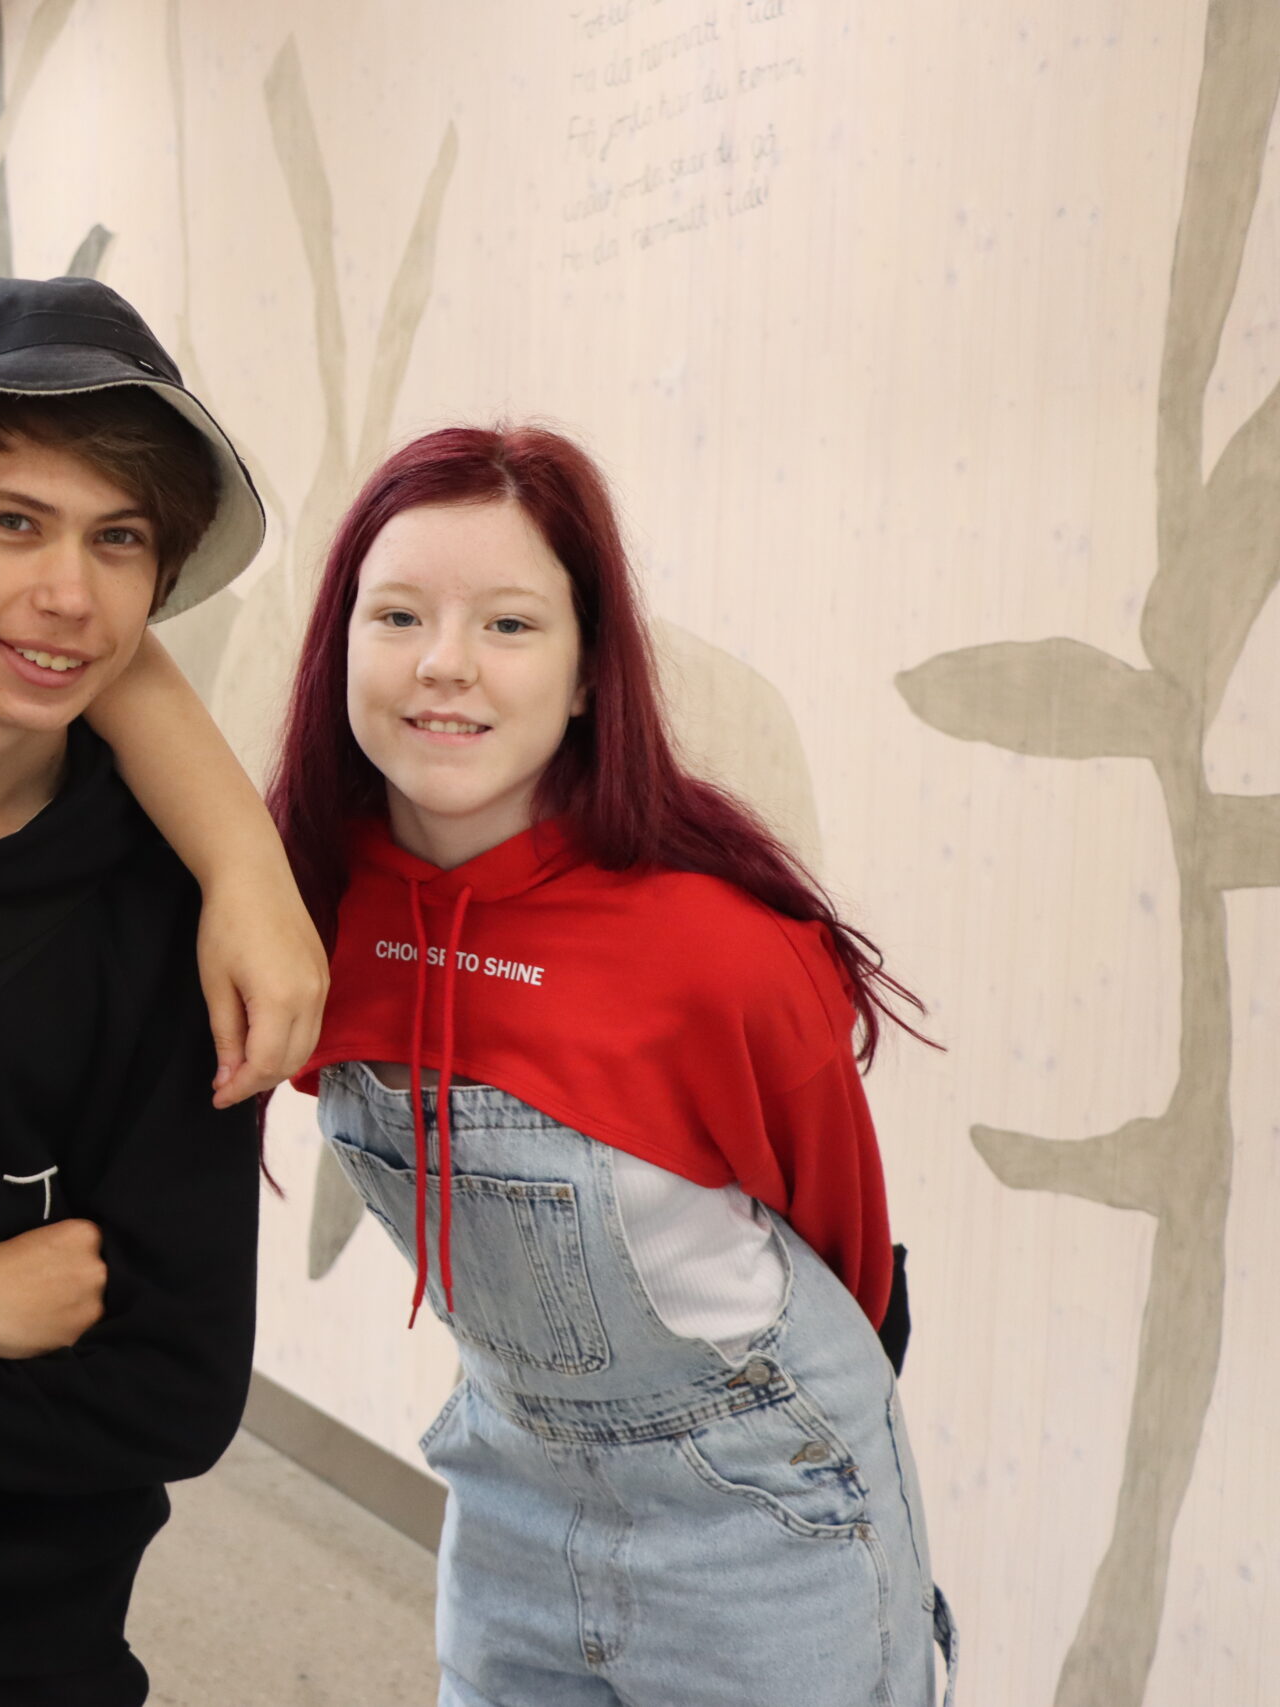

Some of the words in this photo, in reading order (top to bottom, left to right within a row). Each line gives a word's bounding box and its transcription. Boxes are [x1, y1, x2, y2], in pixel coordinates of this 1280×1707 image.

[375, 940, 446, 967] CHOSE
[456, 951, 479, 972] TO
[483, 957, 545, 986] SHINE
